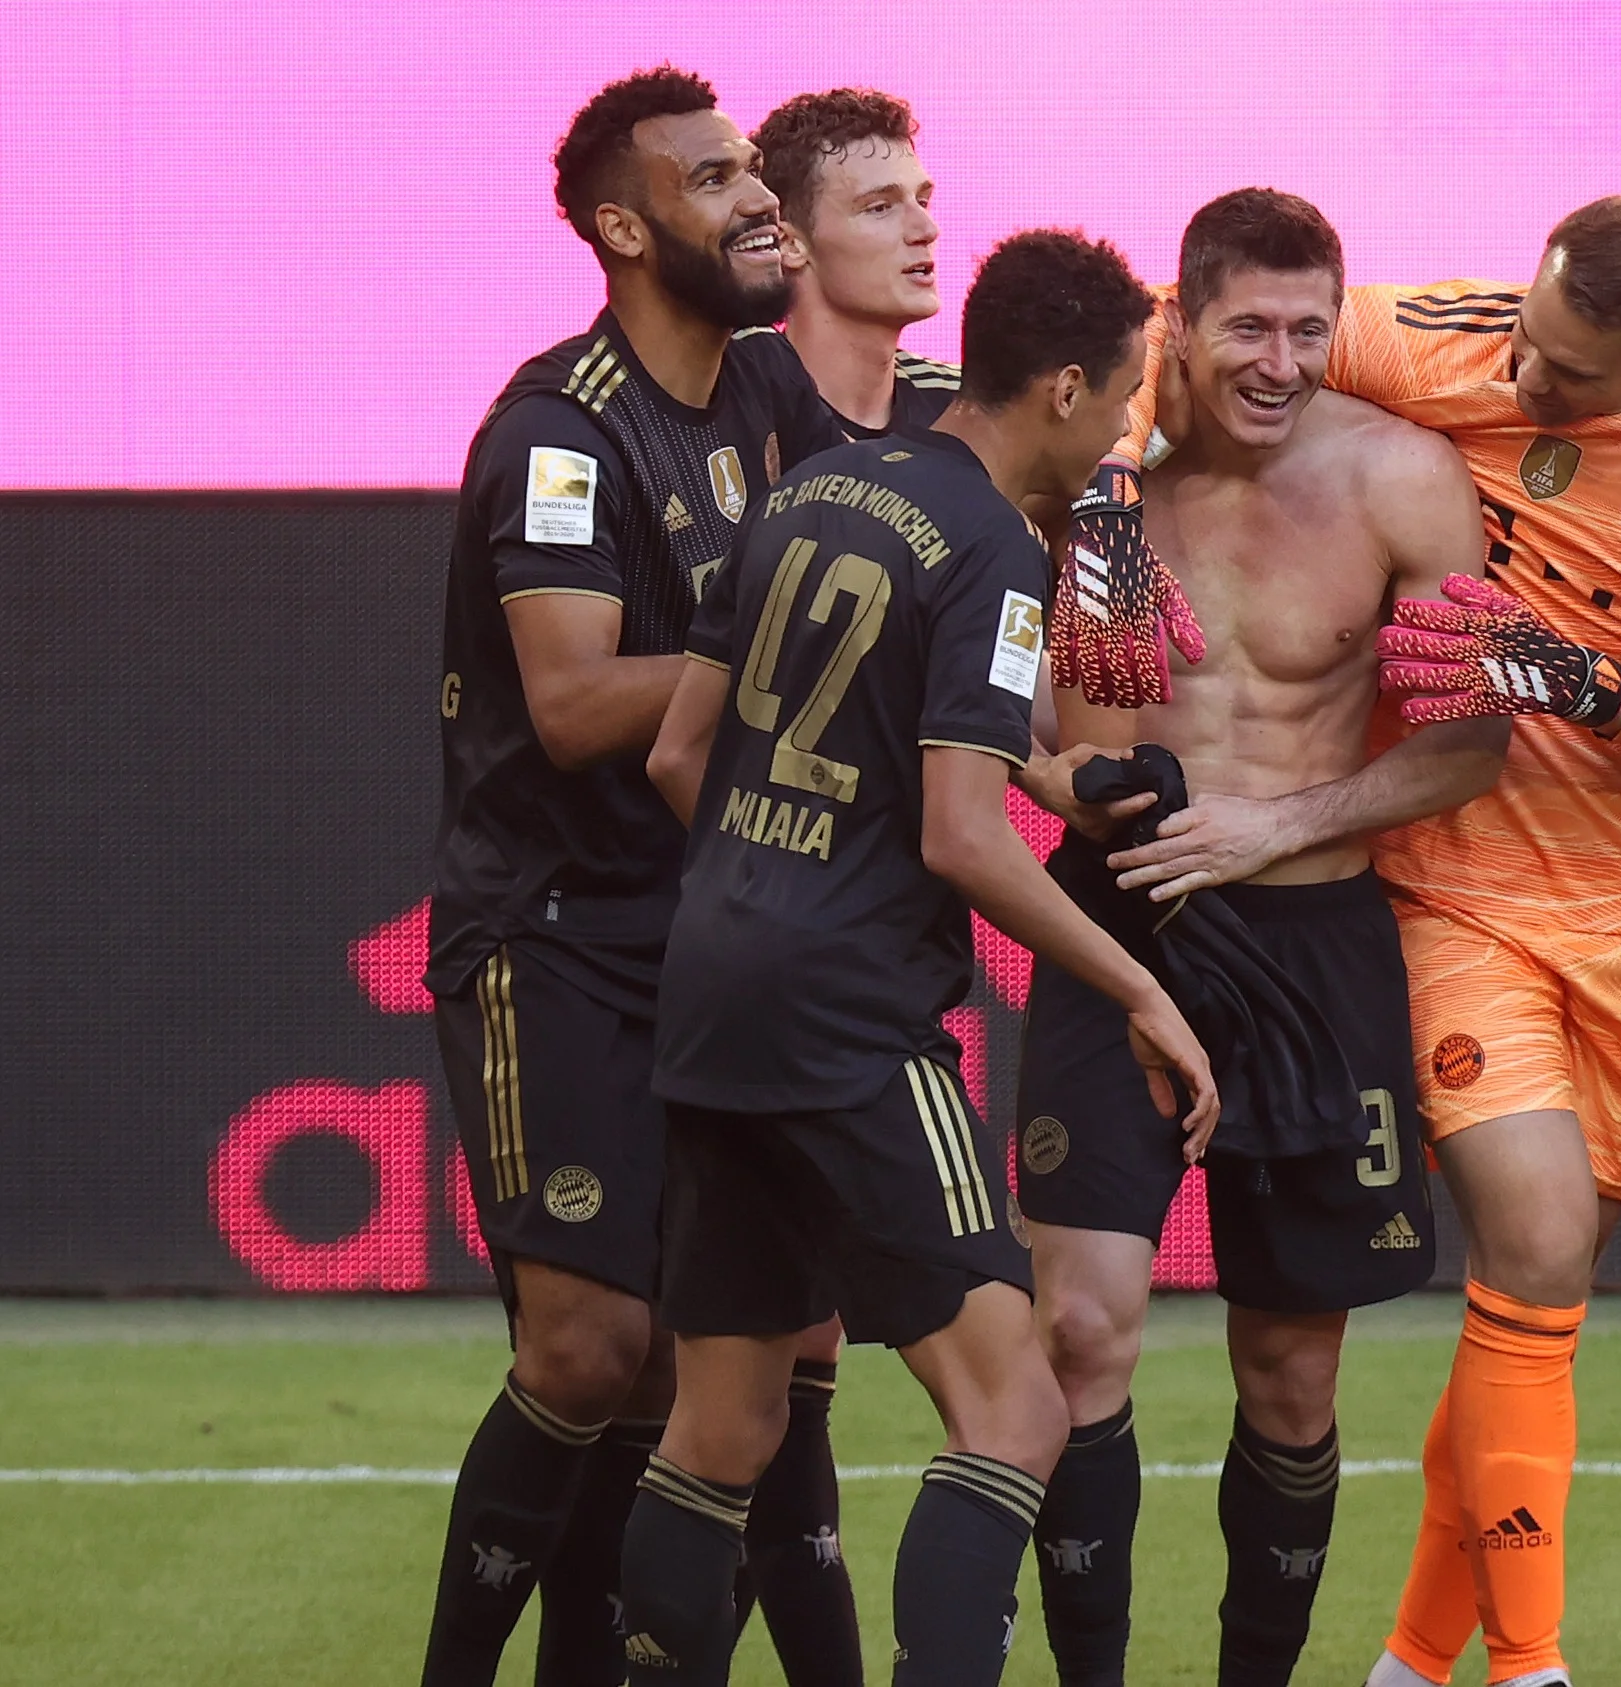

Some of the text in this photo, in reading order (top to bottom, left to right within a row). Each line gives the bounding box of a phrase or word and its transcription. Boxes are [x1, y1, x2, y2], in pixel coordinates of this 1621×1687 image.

[1530, 471, 1555, 488] FIFA
[532, 500, 588, 512] BUNDESLIGA
[763, 473, 952, 571] FC BAYERN MÜNCHEN
[736, 536, 893, 804] 42
[1478, 1531, 1553, 1550] adidas
